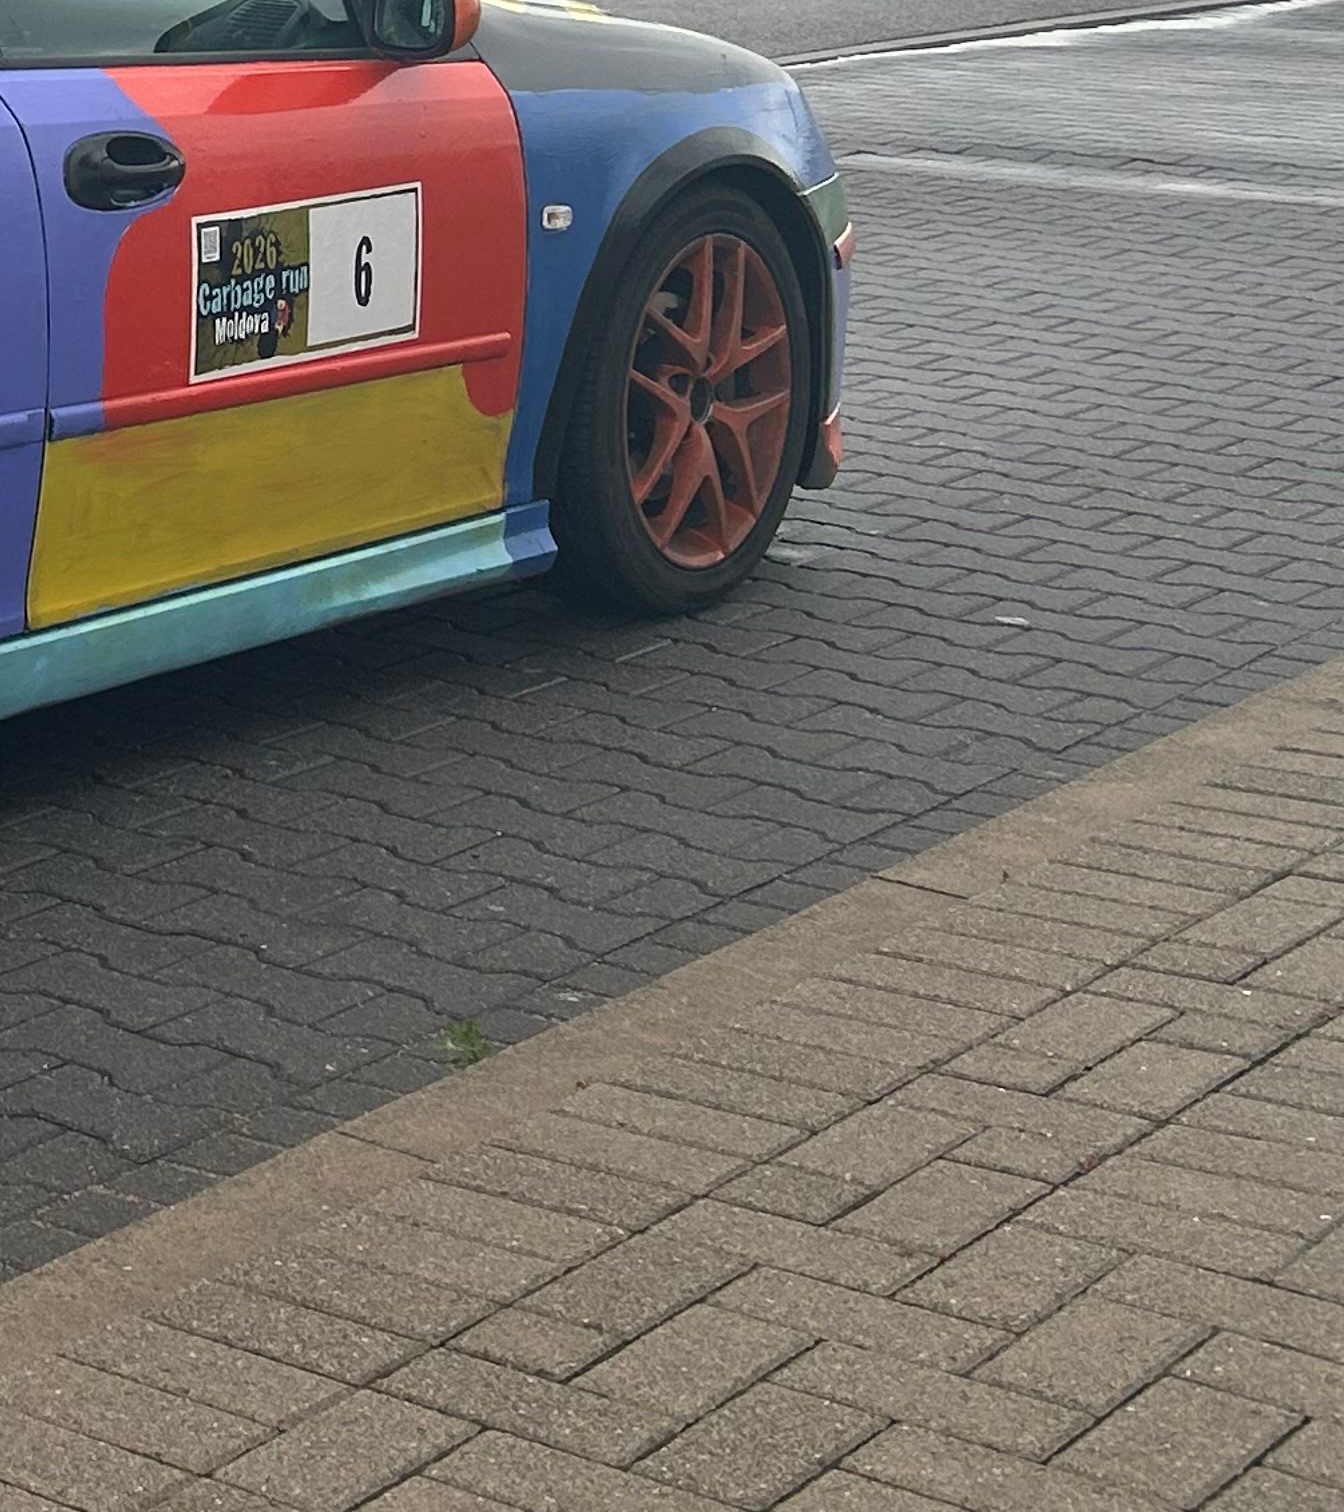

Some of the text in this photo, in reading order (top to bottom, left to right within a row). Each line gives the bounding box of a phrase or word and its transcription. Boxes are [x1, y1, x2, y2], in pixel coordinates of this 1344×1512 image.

[231, 232, 278, 276] 2026
[354, 235, 373, 307] 6
[198, 265, 309, 316] Carbage run
[214, 311, 269, 345] Moldova
